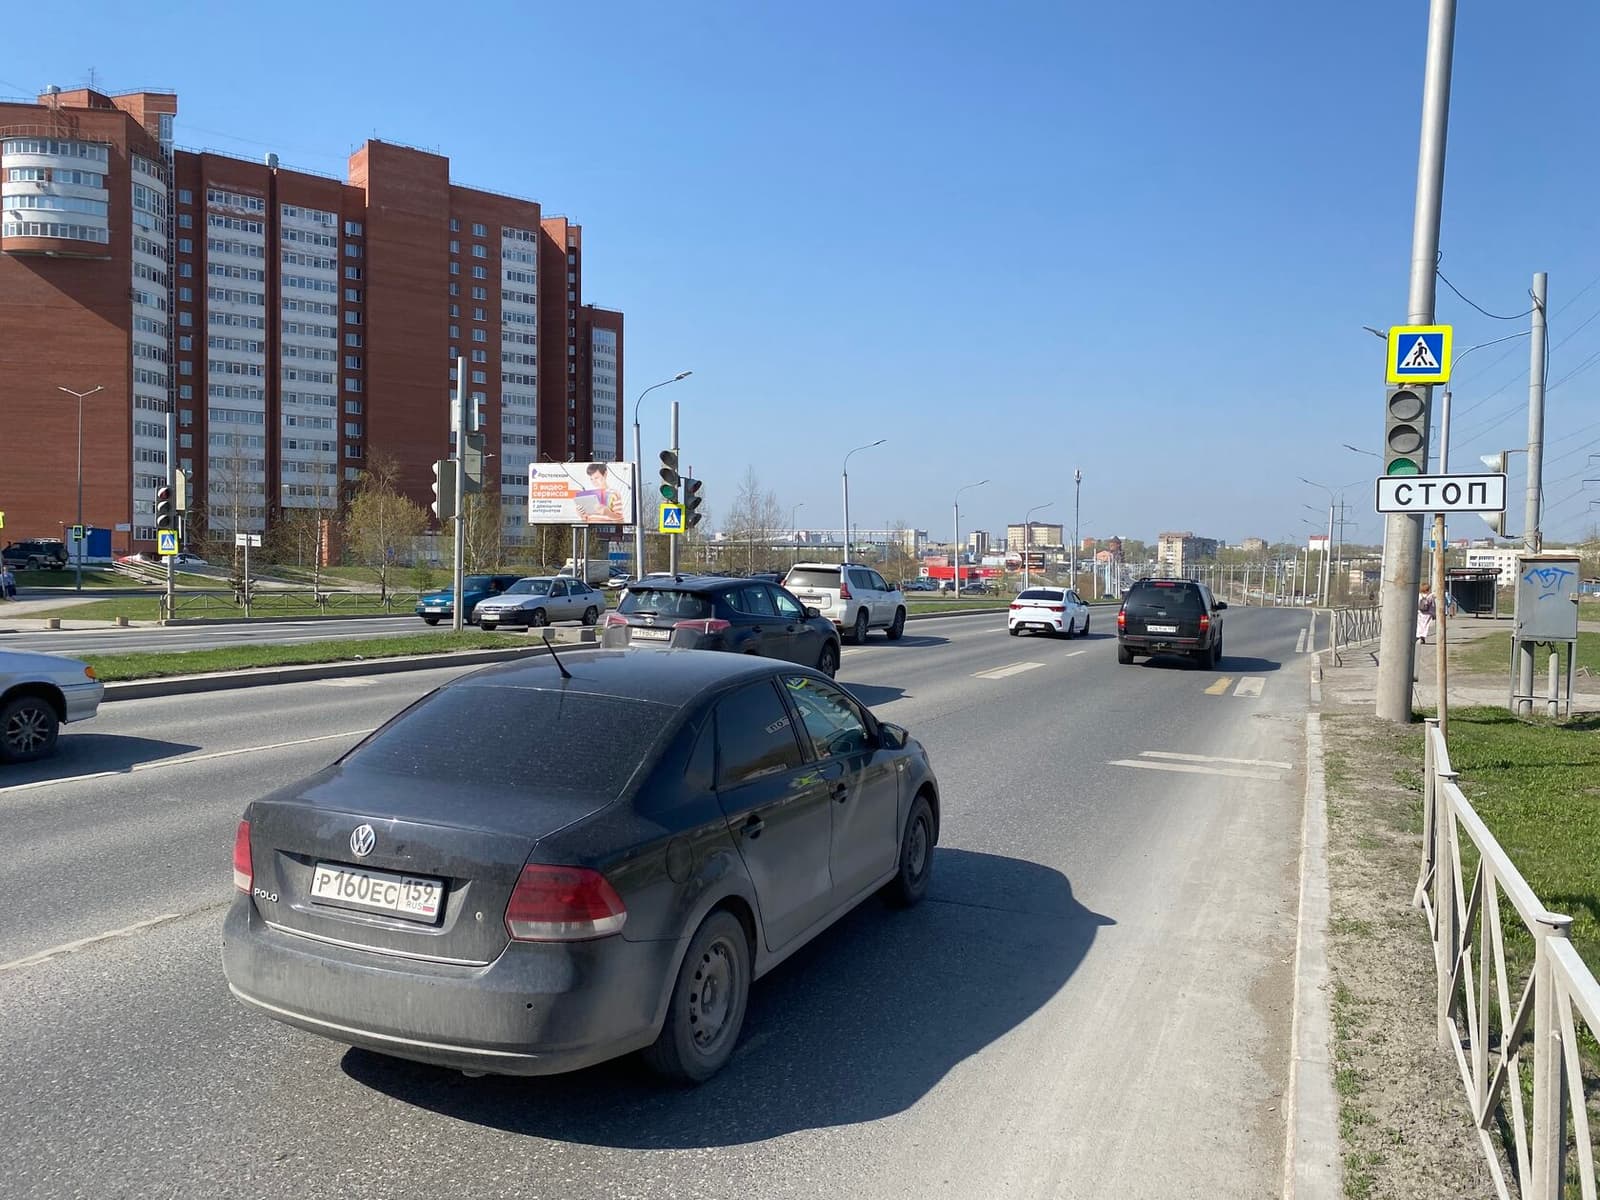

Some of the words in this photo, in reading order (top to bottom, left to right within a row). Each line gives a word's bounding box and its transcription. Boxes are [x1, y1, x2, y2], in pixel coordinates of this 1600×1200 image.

[1394, 482, 1487, 506] СТОП
[254, 887, 279, 902] POLO
[403, 880, 434, 903] 159
[406, 900, 432, 911] RUS
